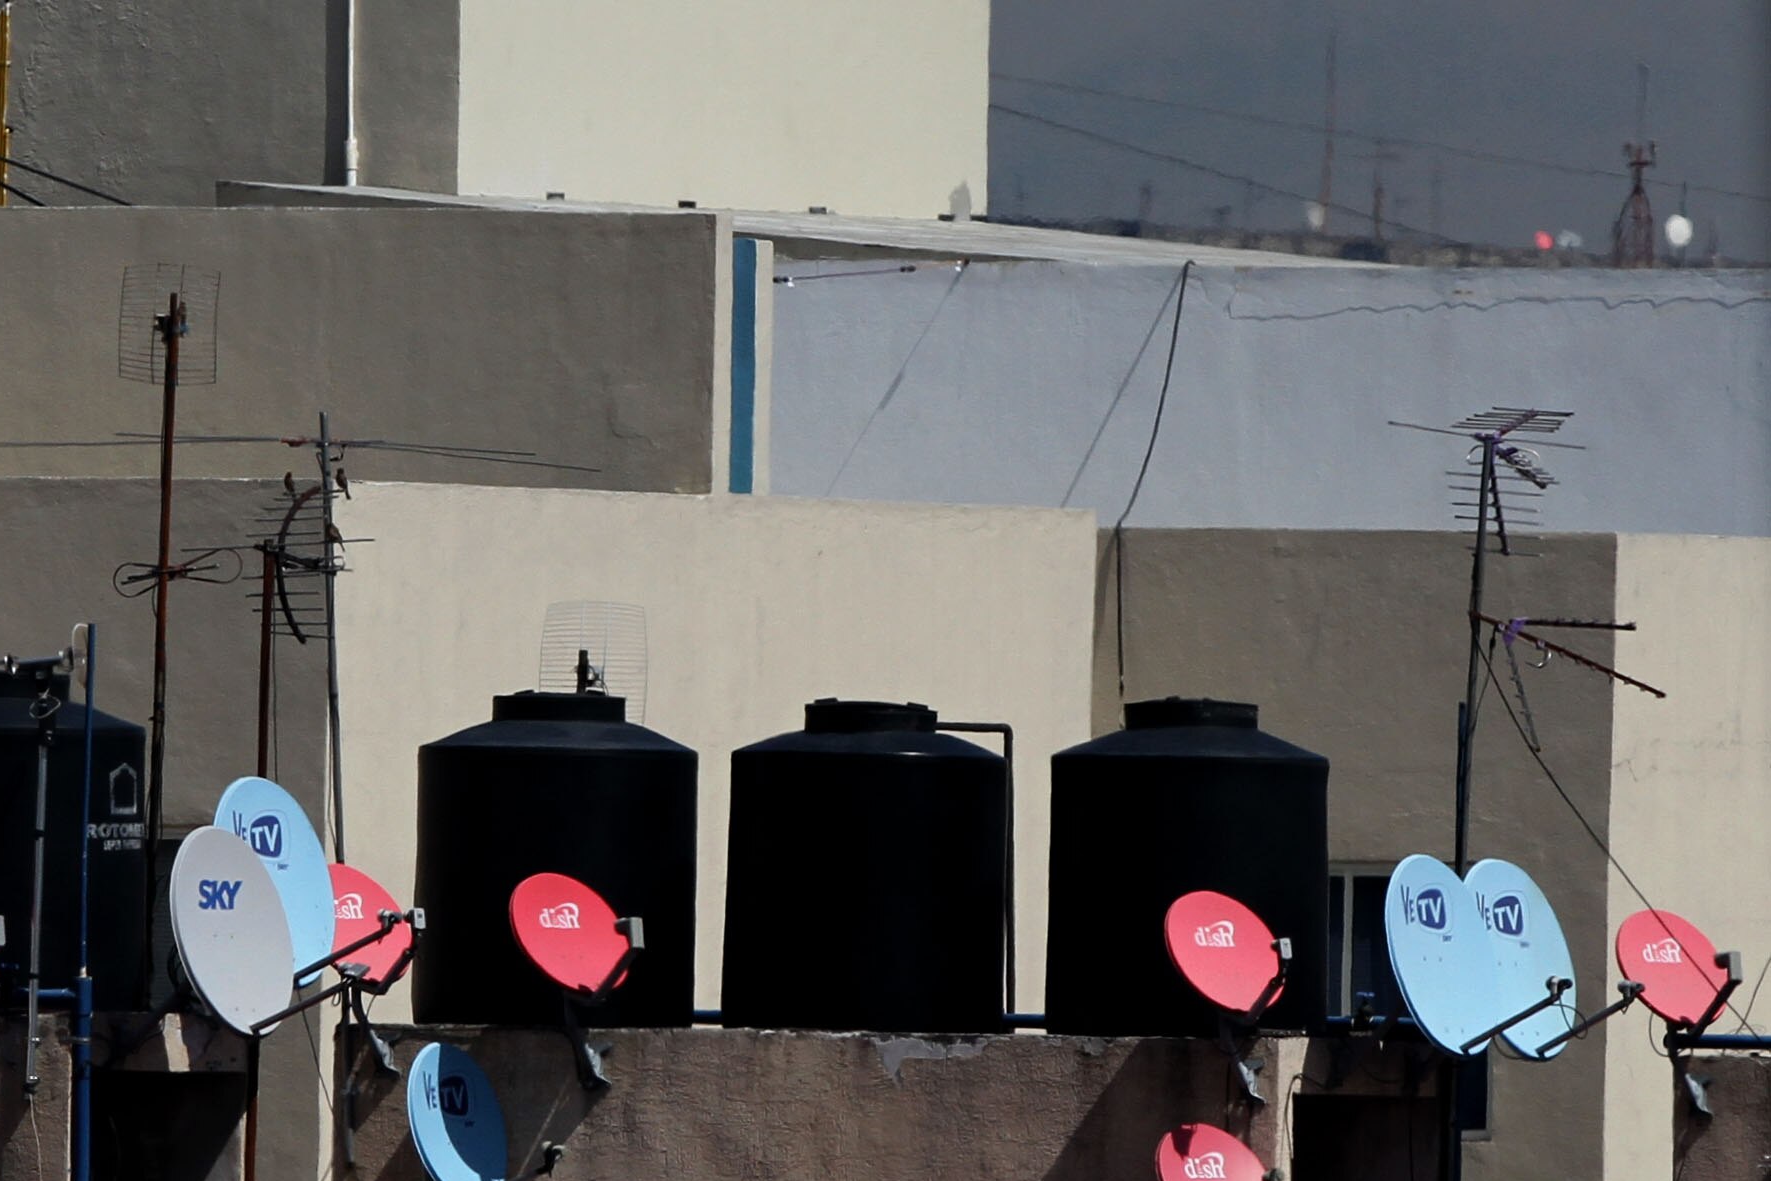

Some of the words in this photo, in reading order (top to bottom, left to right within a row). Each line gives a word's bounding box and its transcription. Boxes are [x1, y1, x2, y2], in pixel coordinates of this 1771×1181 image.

[198, 879, 243, 910] SKY
[333, 893, 364, 920] ish
[539, 902, 581, 929] dish
[1194, 920, 1236, 947] dish
[1642, 938, 1682, 963] dish
[1184, 1152, 1227, 1179] dish
